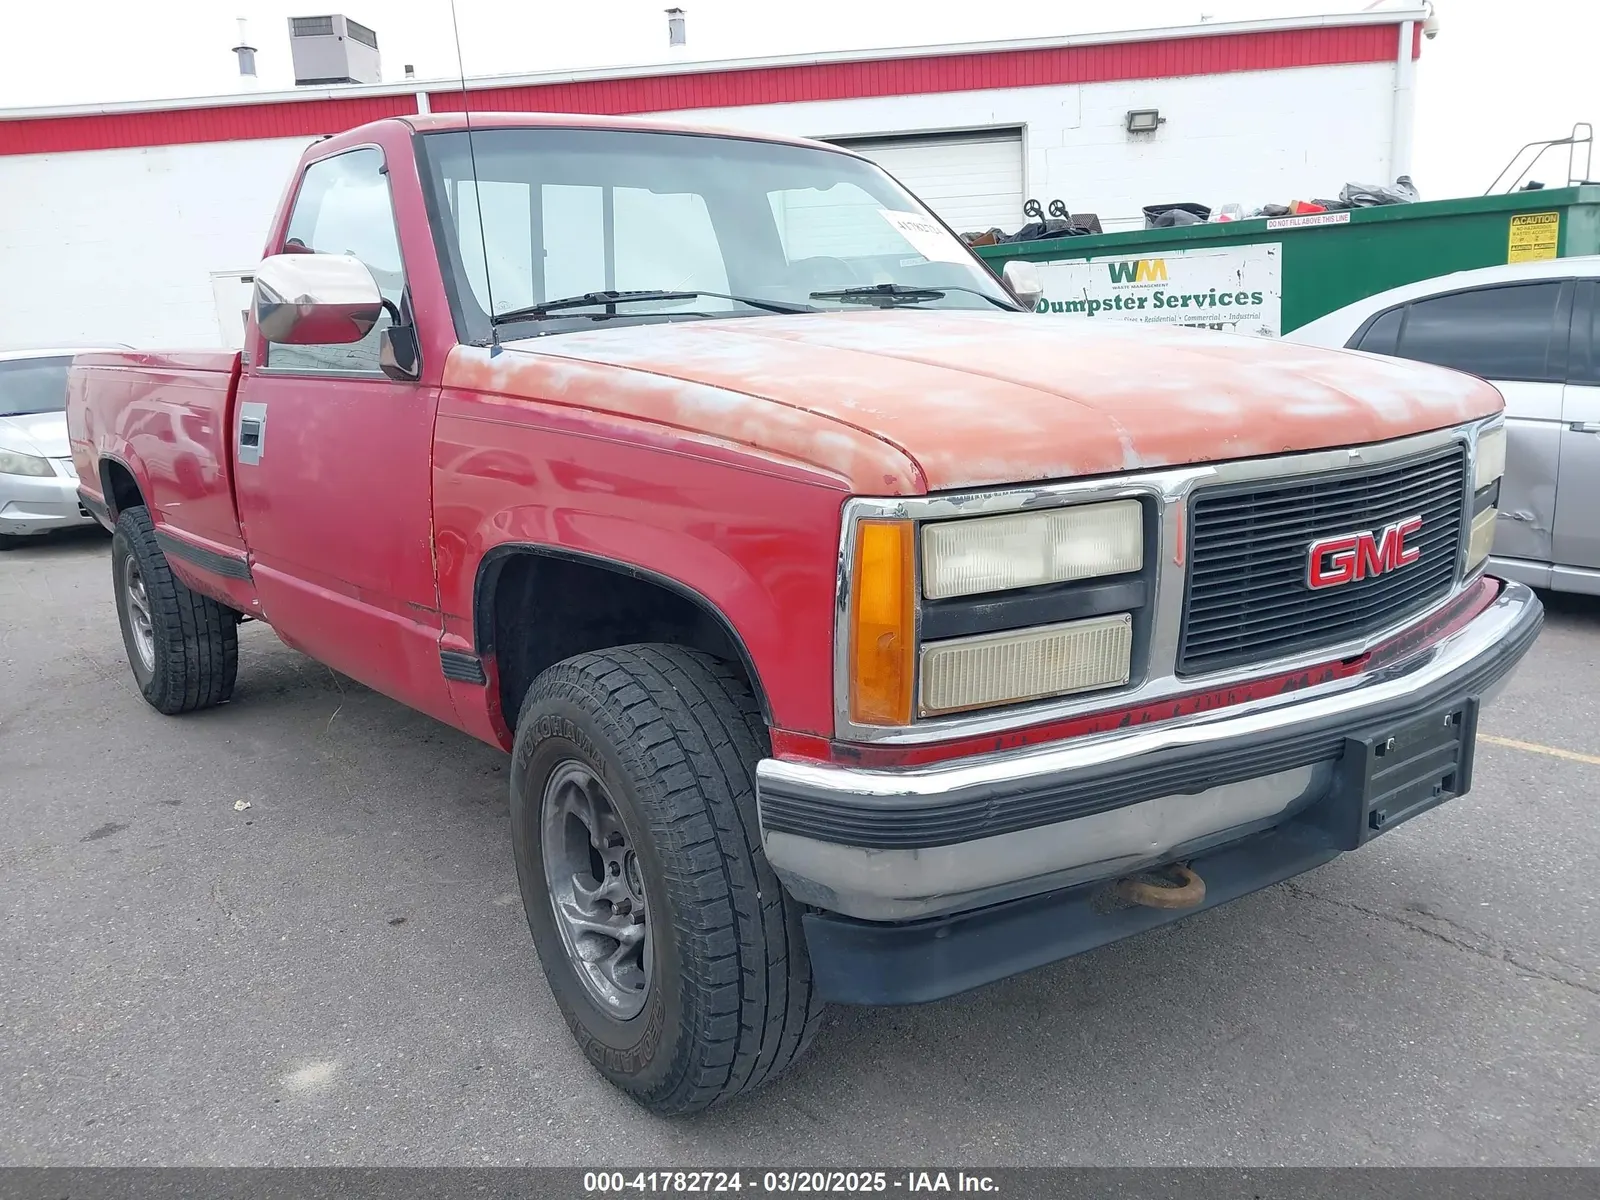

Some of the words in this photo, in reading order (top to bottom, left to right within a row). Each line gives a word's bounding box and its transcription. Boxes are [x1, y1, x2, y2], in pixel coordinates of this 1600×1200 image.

[1302, 217, 1321, 225] ABOVE
[1520, 214, 1557, 224] CAUTION
[1108, 258, 1168, 284] WM
[1036, 293, 1148, 317] Dumpster
[1153, 288, 1264, 309] Services
[1144, 315, 1177, 323] Residential
[1184, 313, 1221, 322] Commercial
[1229, 312, 1261, 320] Industrial
[1307, 515, 1422, 590] GMC
[519, 714, 607, 777] YOKOHAMA
